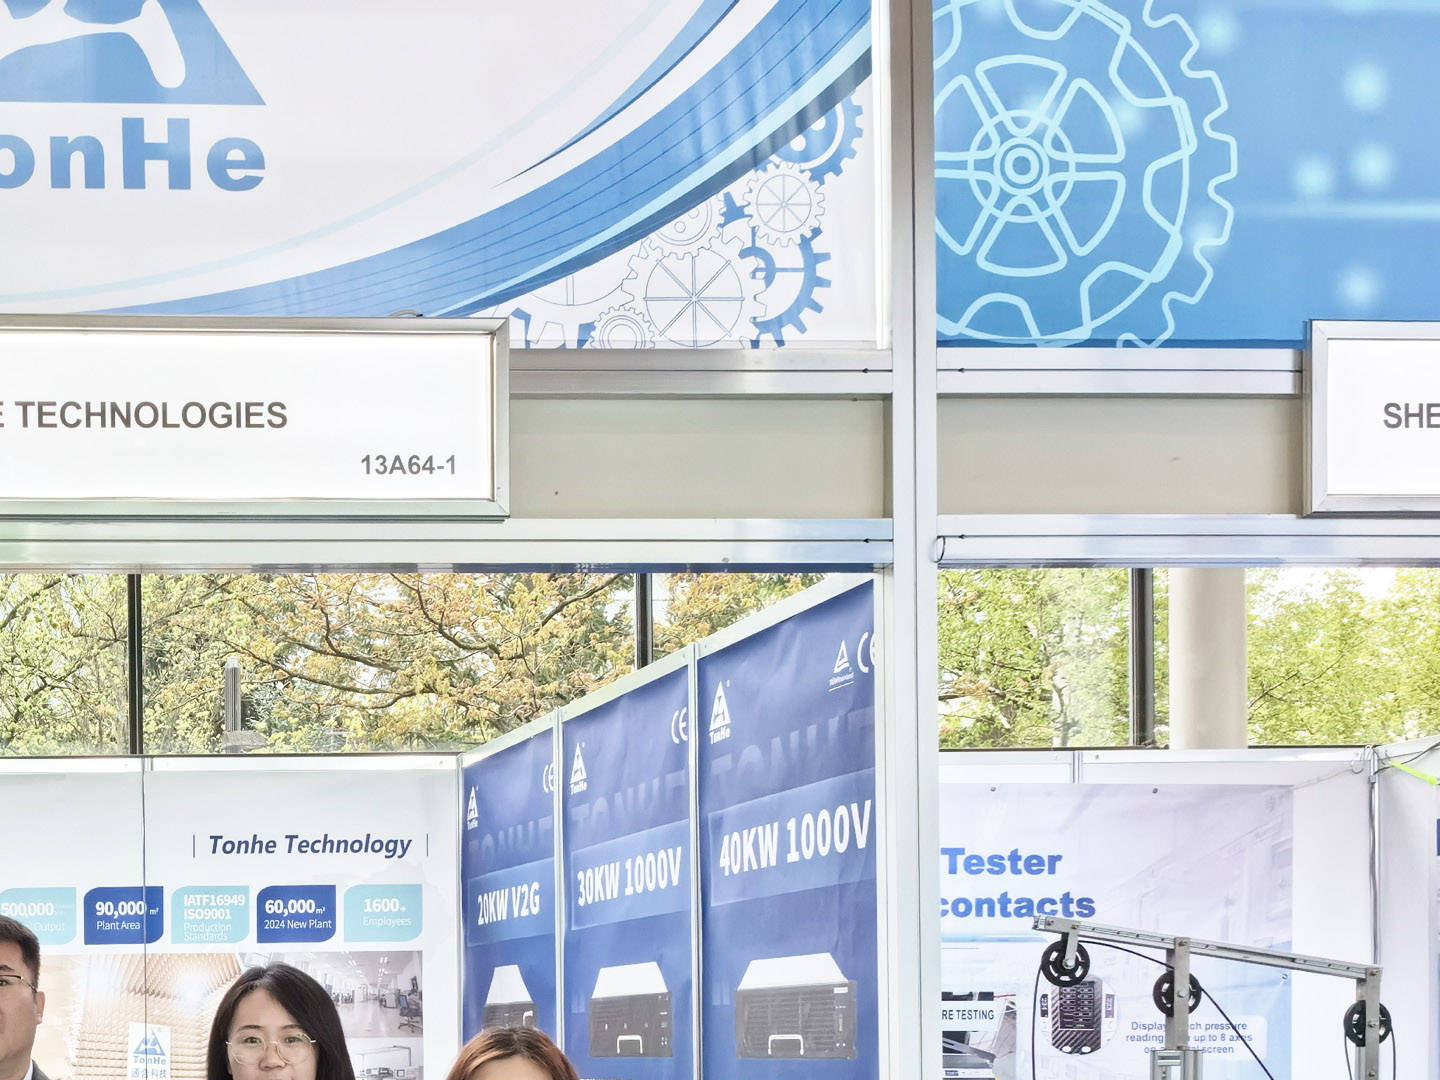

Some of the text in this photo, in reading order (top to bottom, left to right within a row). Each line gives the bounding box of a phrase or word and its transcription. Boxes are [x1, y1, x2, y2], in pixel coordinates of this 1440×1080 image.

[14, 400, 289, 430] TECHNOLOGIES
[361, 454, 458, 477] 13A64-1
[719, 800, 872, 877] 40KW 1000V
[209, 833, 412, 859] Tonhe Technology
[940, 847, 1063, 876] Tester
[577, 846, 682, 907] 30KW 1000V
[184, 894, 246, 907] IATF16949
[477, 881, 540, 925] 20KW V2G
[940, 891, 1096, 918] contacts
[95, 901, 146, 919] 90,000
[184, 908, 232, 920] ISO9001
[96, 920, 141, 930] Plant Area
[183, 922, 232, 932] Production
[264, 918, 332, 930] 2024 New Plant
[363, 916, 412, 928] Employees
[183, 931, 228, 941] Standards
[956, 1009, 994, 1020] TESTING
[1194, 1034, 1205, 1044] up
[1209, 1033, 1218, 1042] to
[1220, 1033, 1226, 1042] 8
[133, 1055, 166, 1065] TonHe
